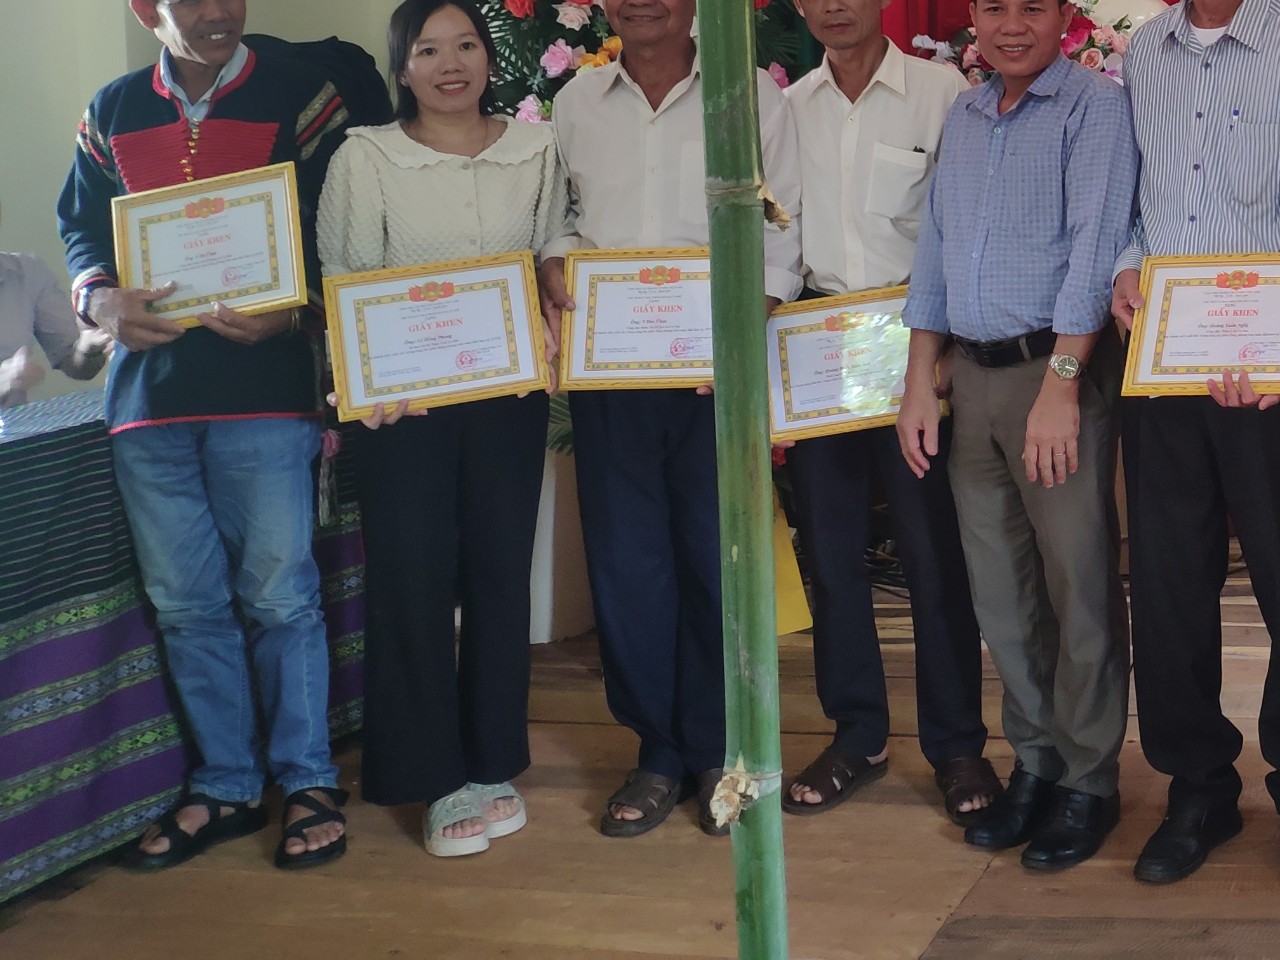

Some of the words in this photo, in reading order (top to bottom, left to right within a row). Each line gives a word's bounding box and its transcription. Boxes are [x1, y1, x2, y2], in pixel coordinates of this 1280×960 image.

[657, 304, 683, 313] KHEN
[1207, 307, 1229, 317] GIẤY
[1232, 308, 1260, 317] KHEN
[435, 317, 464, 329] KHEN
